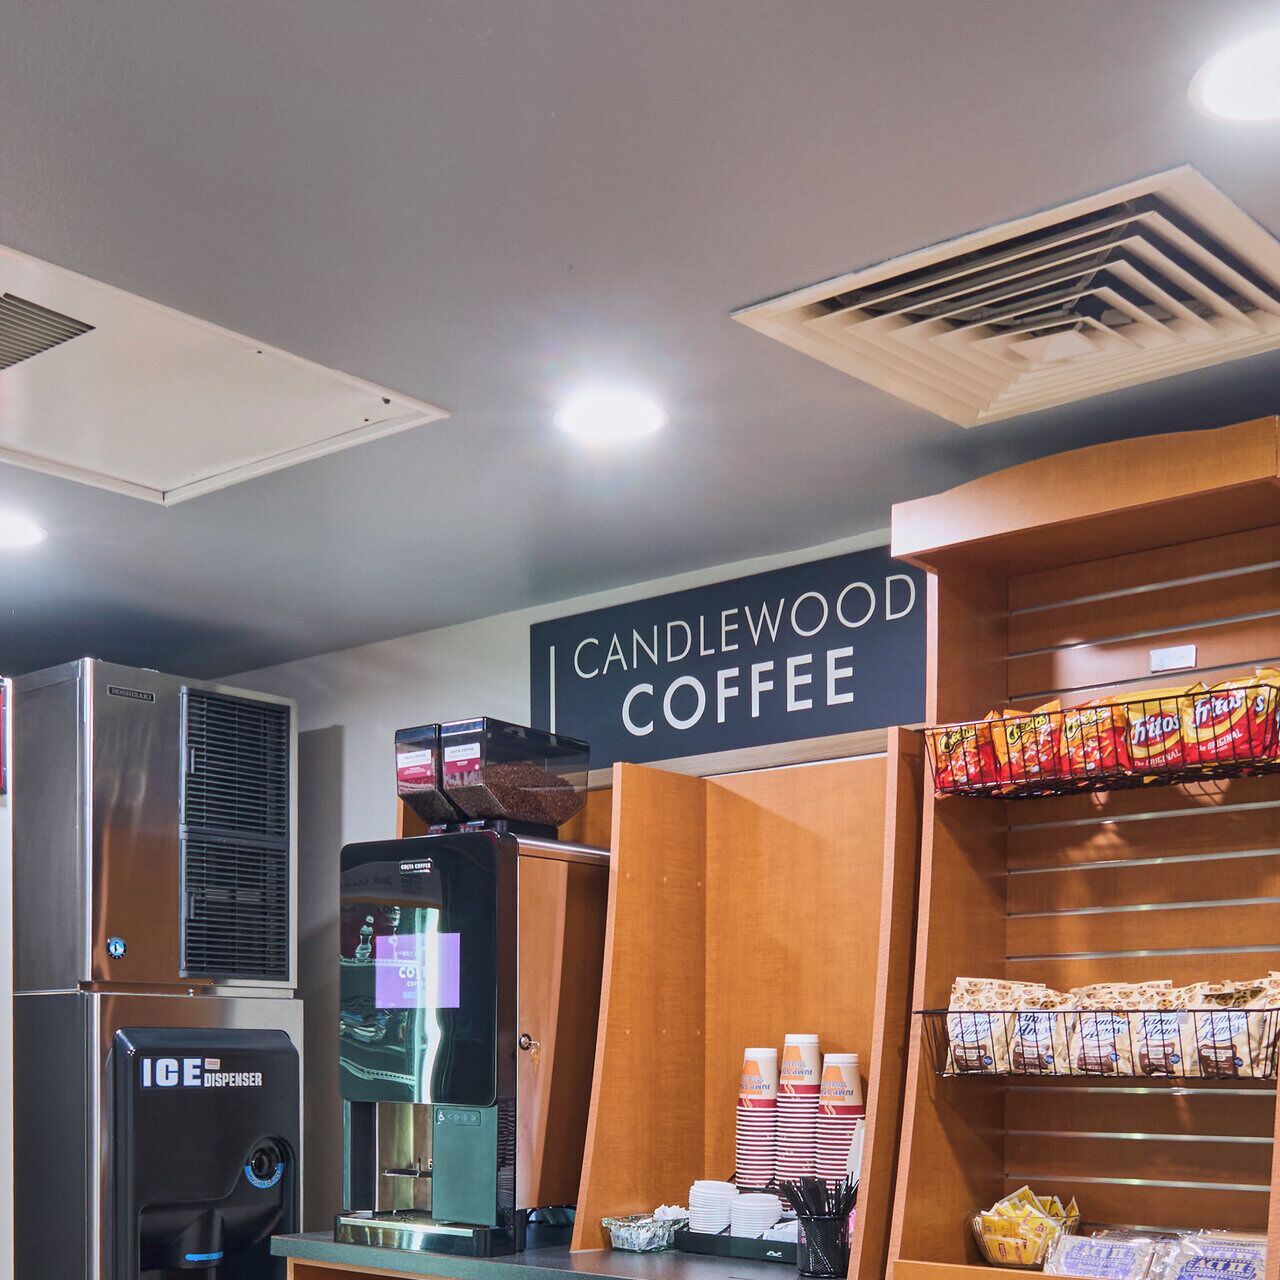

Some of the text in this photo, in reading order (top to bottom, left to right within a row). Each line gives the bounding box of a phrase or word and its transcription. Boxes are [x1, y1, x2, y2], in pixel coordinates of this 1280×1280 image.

[574, 573, 917, 679] CANDLEWOOD
[111, 687, 152, 701] HOSHIZAKI
[622, 646, 854, 737] COFFEE
[1194, 688, 1247, 727] Fritos
[1131, 714, 1181, 745] Fritos
[401, 862, 431, 871] COSTA COFFEE
[142, 1058, 202, 1087] ICE
[204, 1073, 262, 1087] DISPENSER
